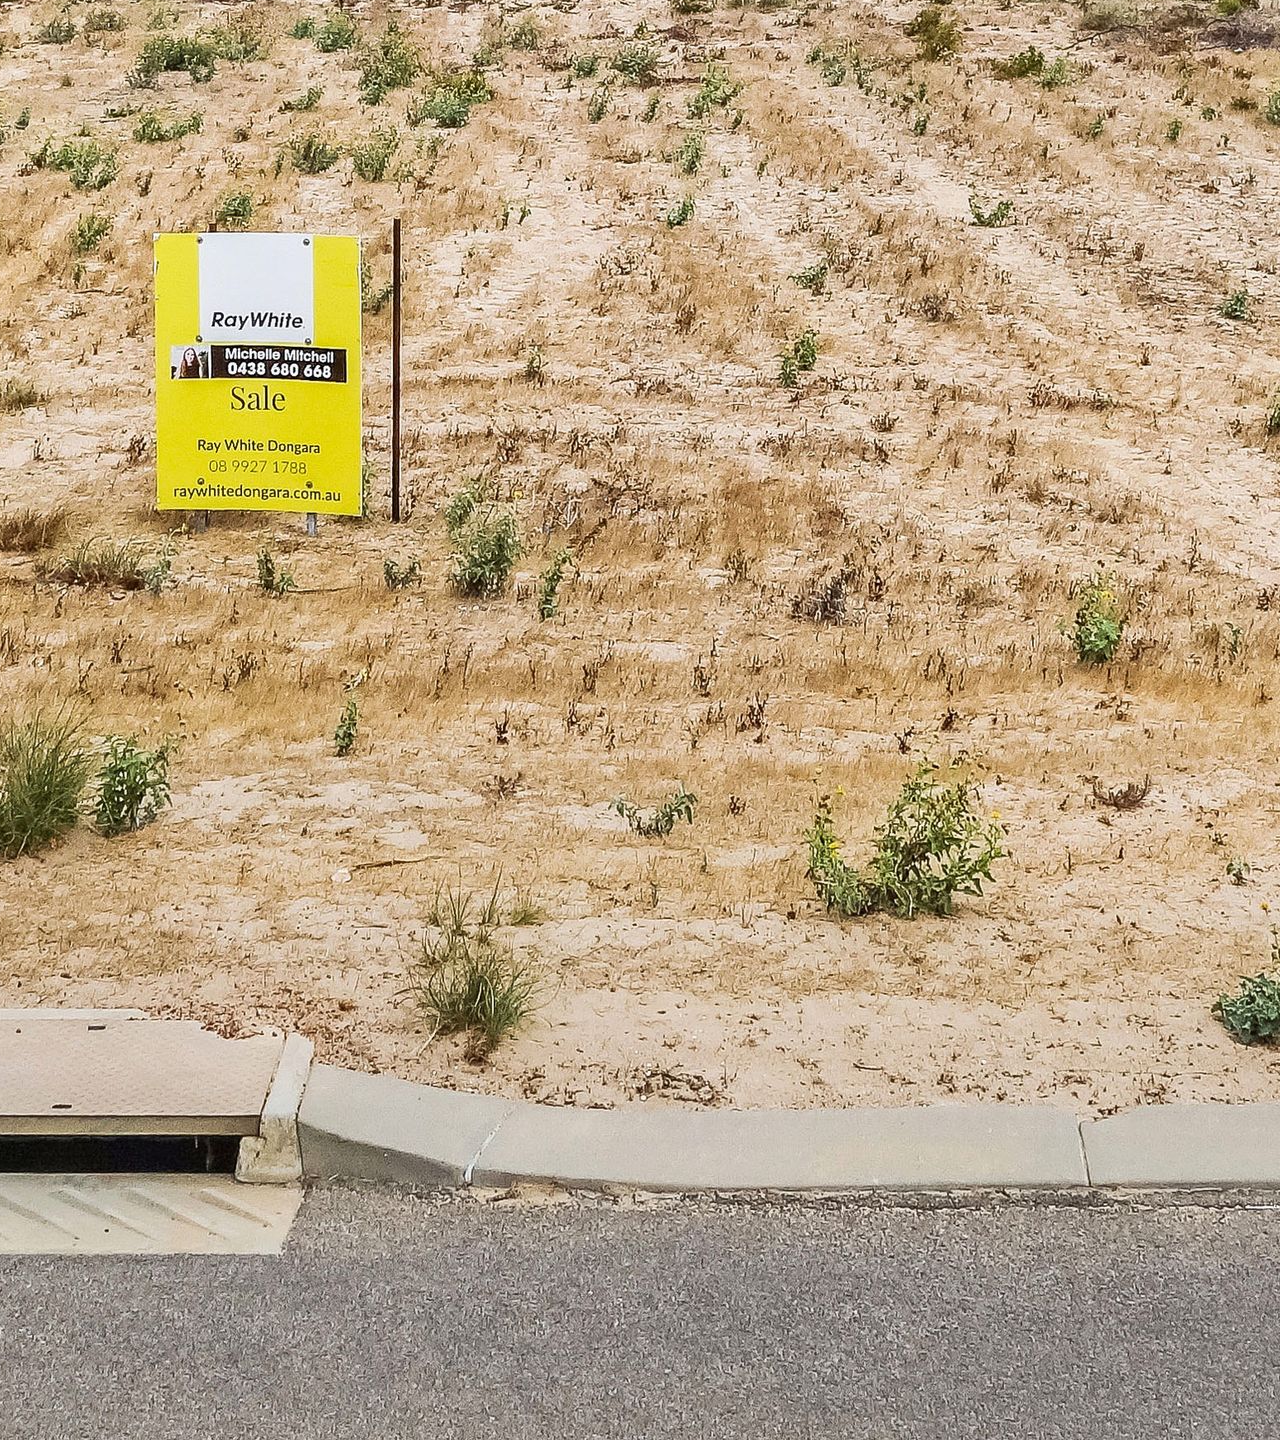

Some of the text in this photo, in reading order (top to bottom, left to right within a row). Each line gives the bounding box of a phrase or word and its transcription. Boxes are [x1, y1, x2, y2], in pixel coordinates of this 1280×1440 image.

[225, 348, 334, 363] Michelle Mitchell
[227, 362, 332, 378] 0438 680 668
[231, 385, 286, 411] Sale
[197, 439, 321, 455] Ray White Dongara
[209, 460, 307, 474] 08 9927 1788
[173, 484, 341, 502] raywhitedongara.com.au
